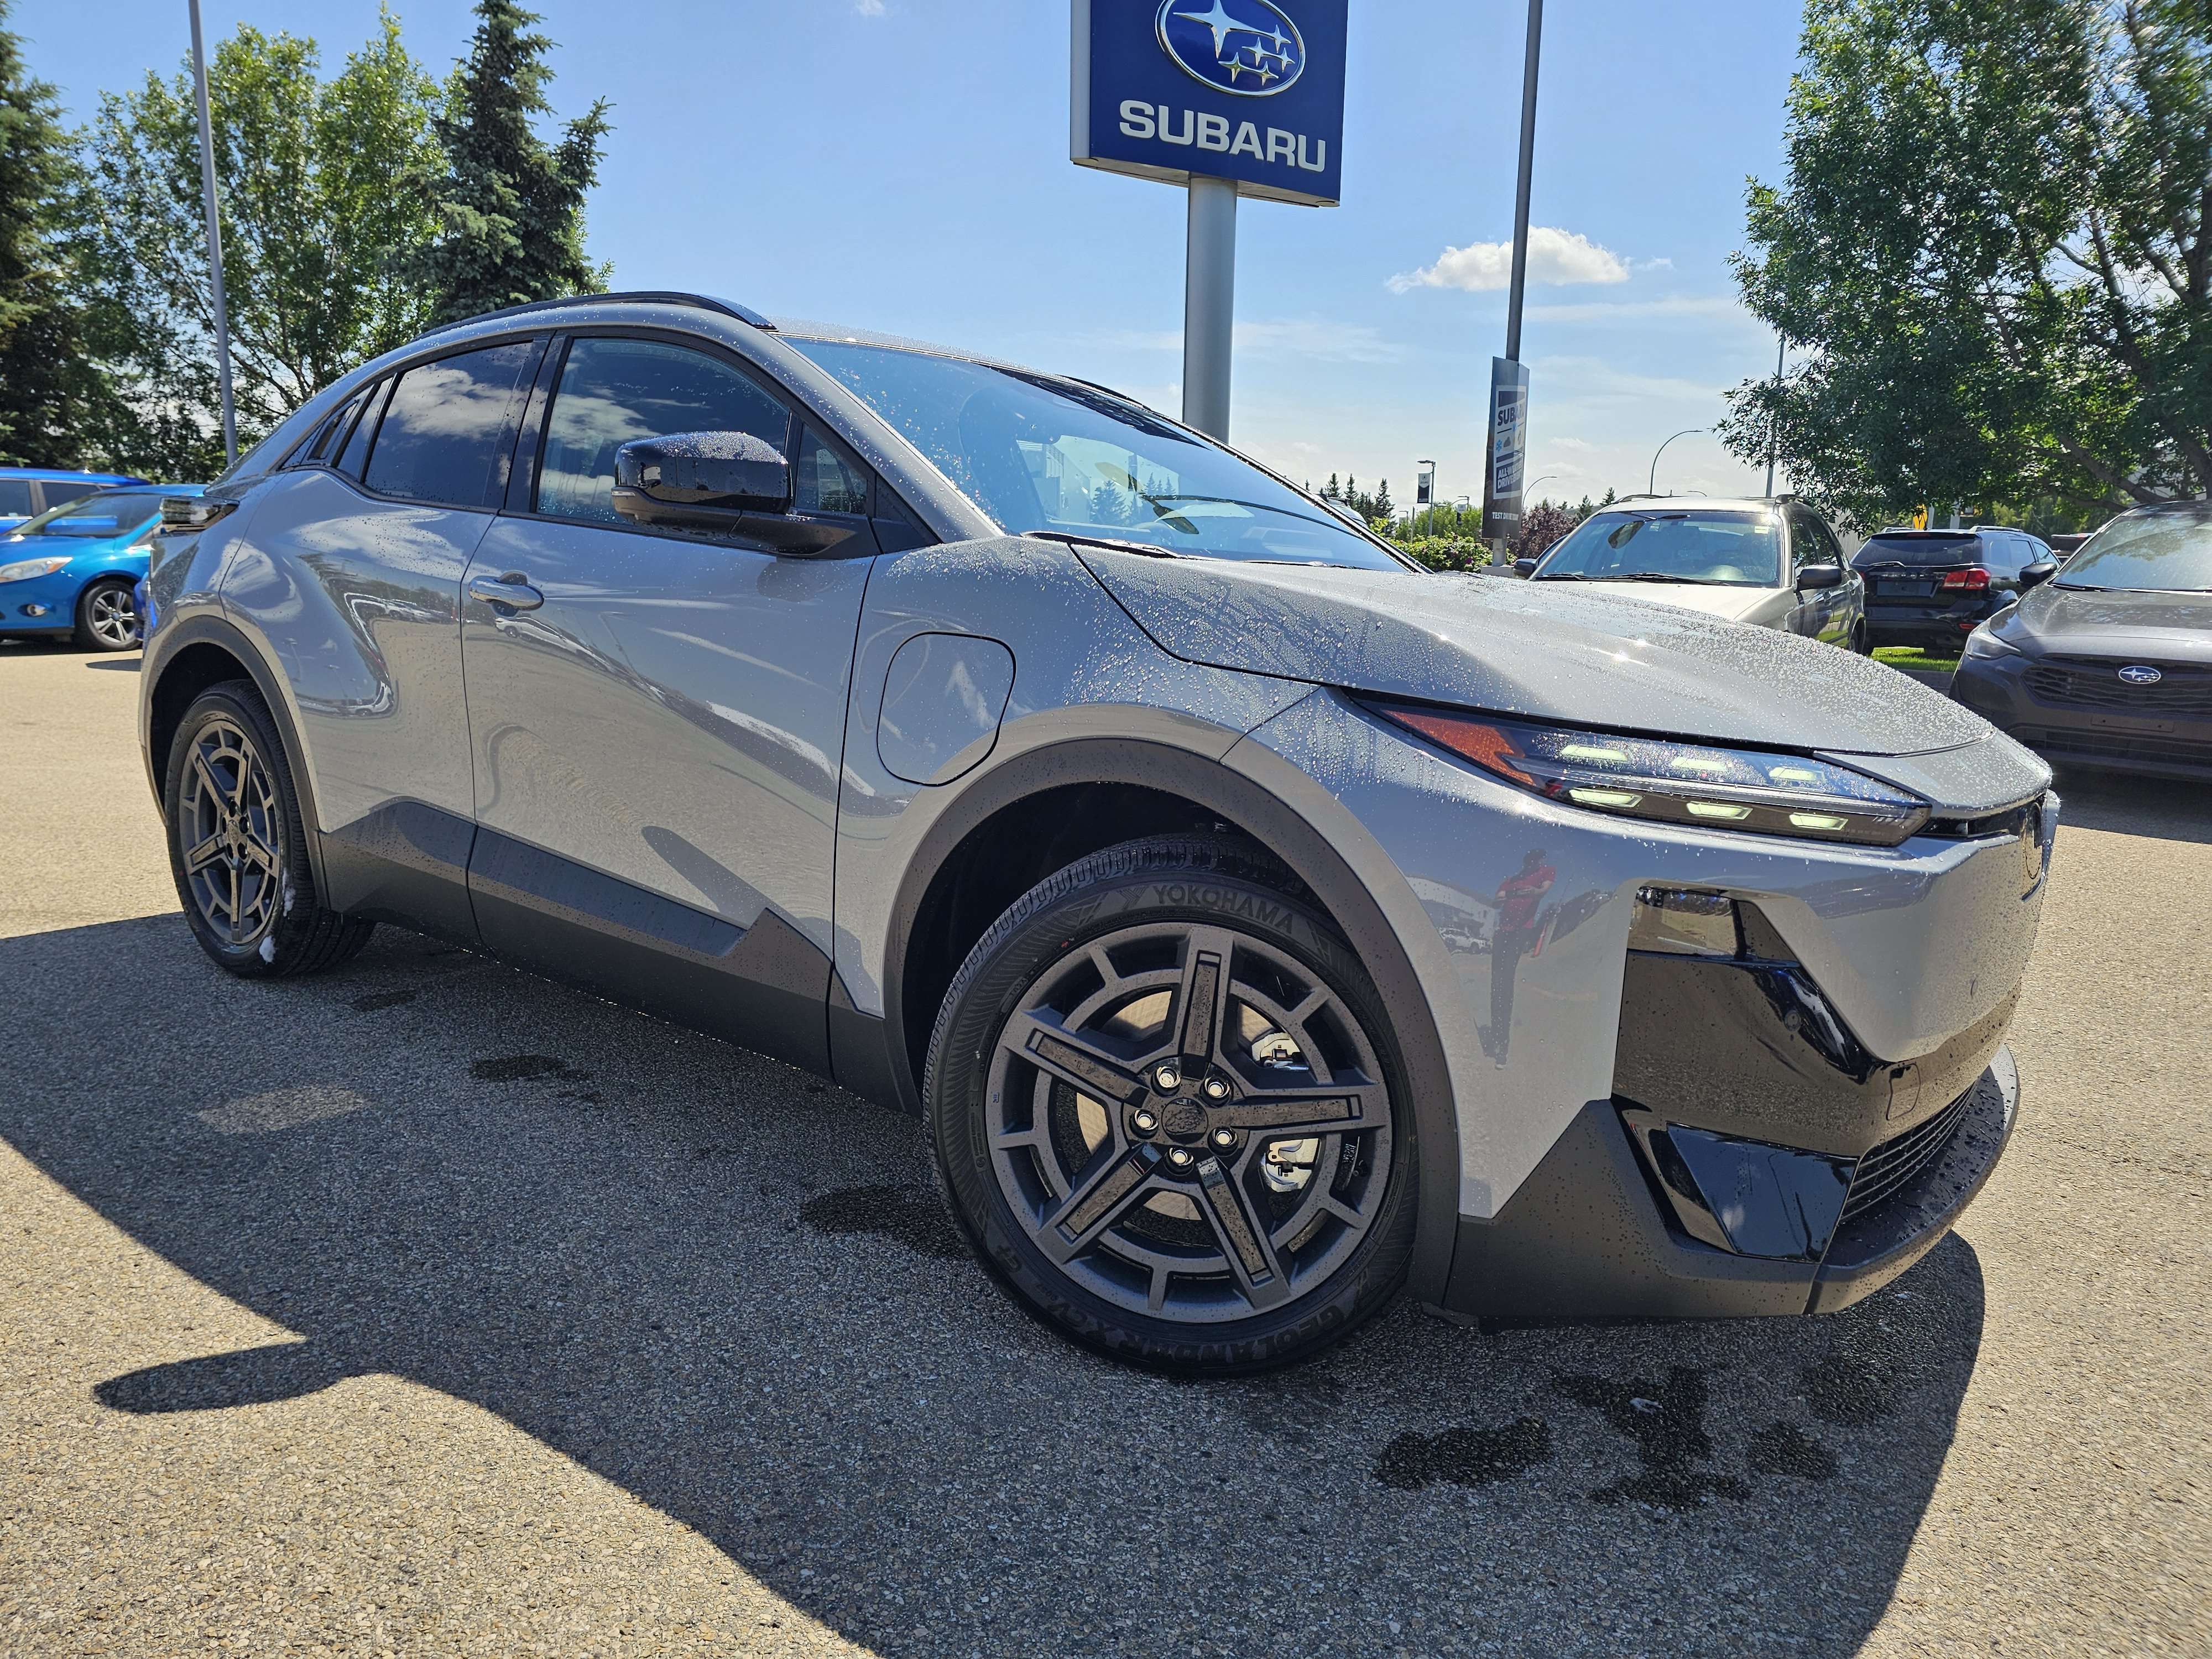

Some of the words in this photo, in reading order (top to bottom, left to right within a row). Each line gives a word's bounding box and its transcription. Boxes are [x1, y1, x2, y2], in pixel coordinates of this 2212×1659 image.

[1119, 100, 1326, 172] SUBARU
[1498, 460, 1522, 479] ALL-W
[1152, 884, 1293, 934] YOKOHAMA
